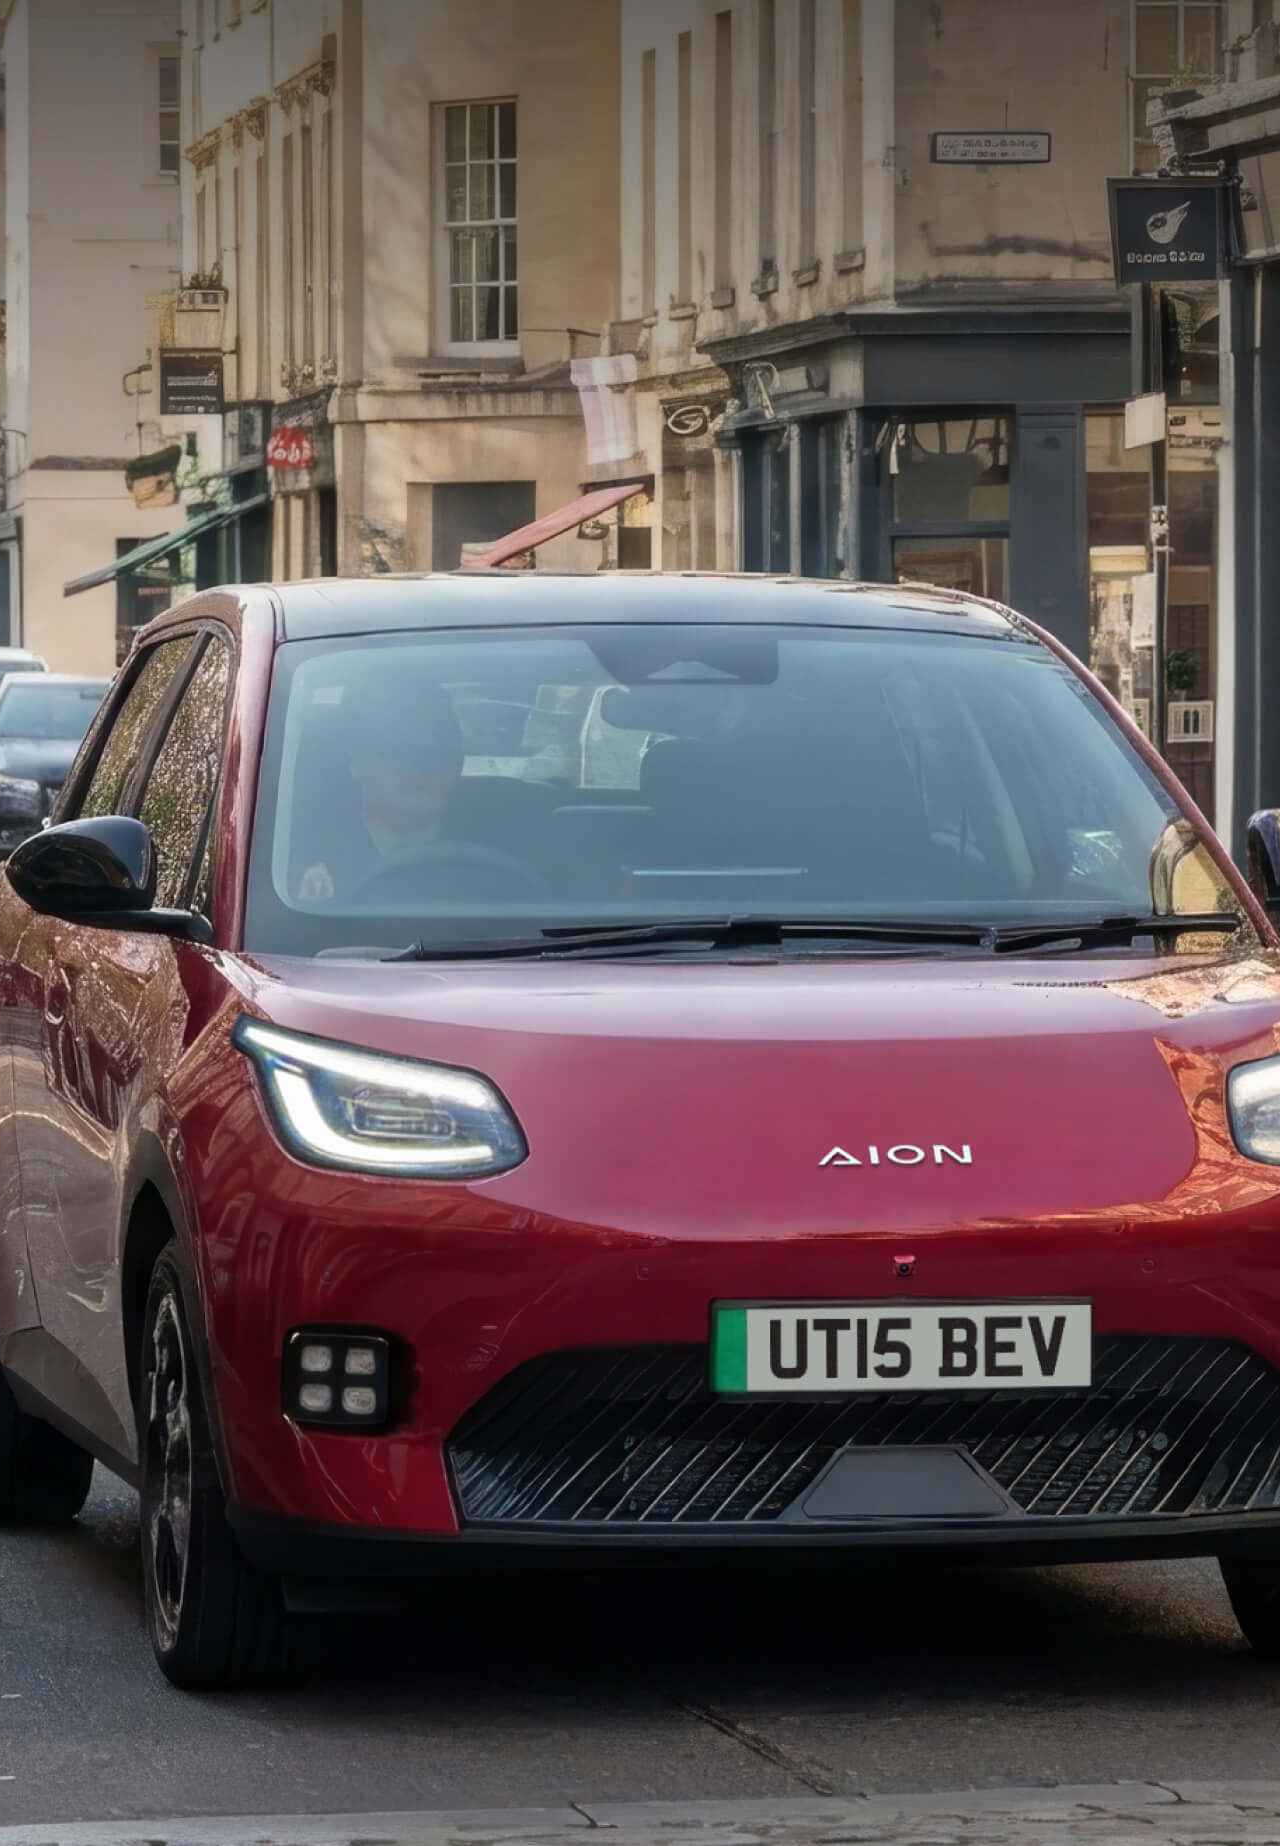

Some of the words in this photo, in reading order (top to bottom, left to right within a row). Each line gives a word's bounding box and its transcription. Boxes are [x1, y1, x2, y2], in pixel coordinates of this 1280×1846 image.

[818, 1144, 973, 1166] AION
[769, 1317, 912, 1379] UT15
[938, 1315, 1067, 1377] BEV
